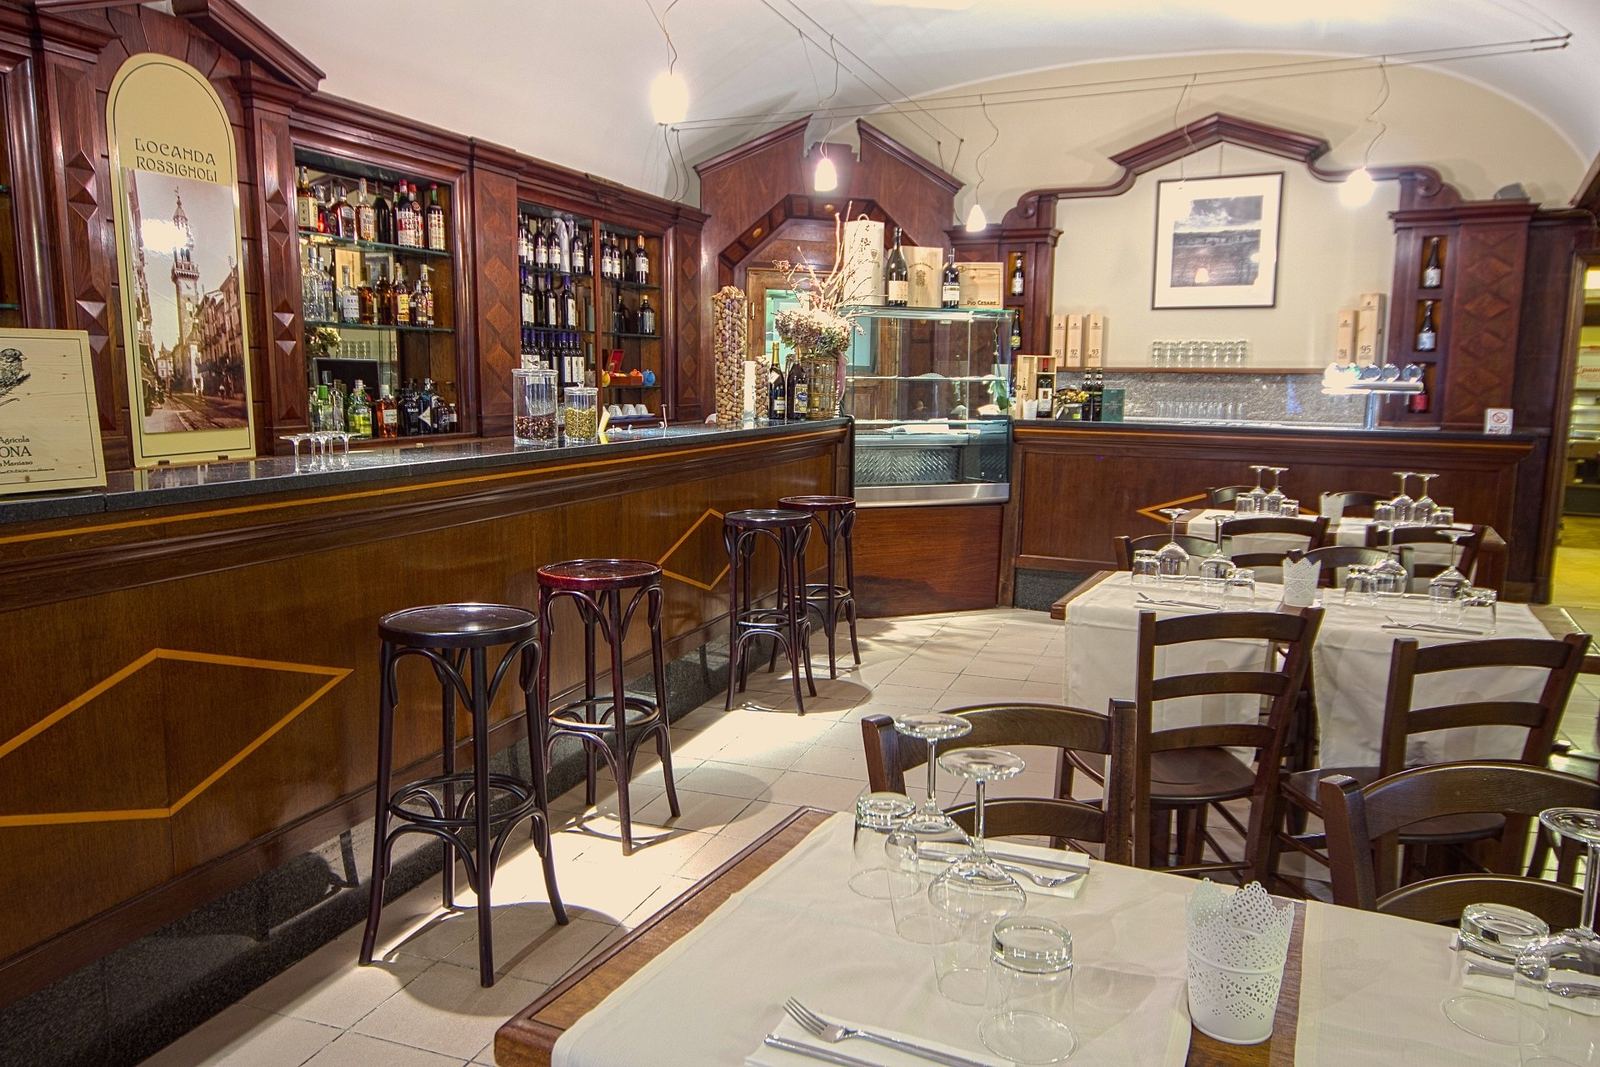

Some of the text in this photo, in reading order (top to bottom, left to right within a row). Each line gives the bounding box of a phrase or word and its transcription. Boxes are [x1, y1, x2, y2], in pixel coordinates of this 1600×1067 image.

[135, 138, 216, 166] LOCANDA
[136, 156, 218, 182] ROSSIGNOLI
[1360, 344, 1372, 354] 95
